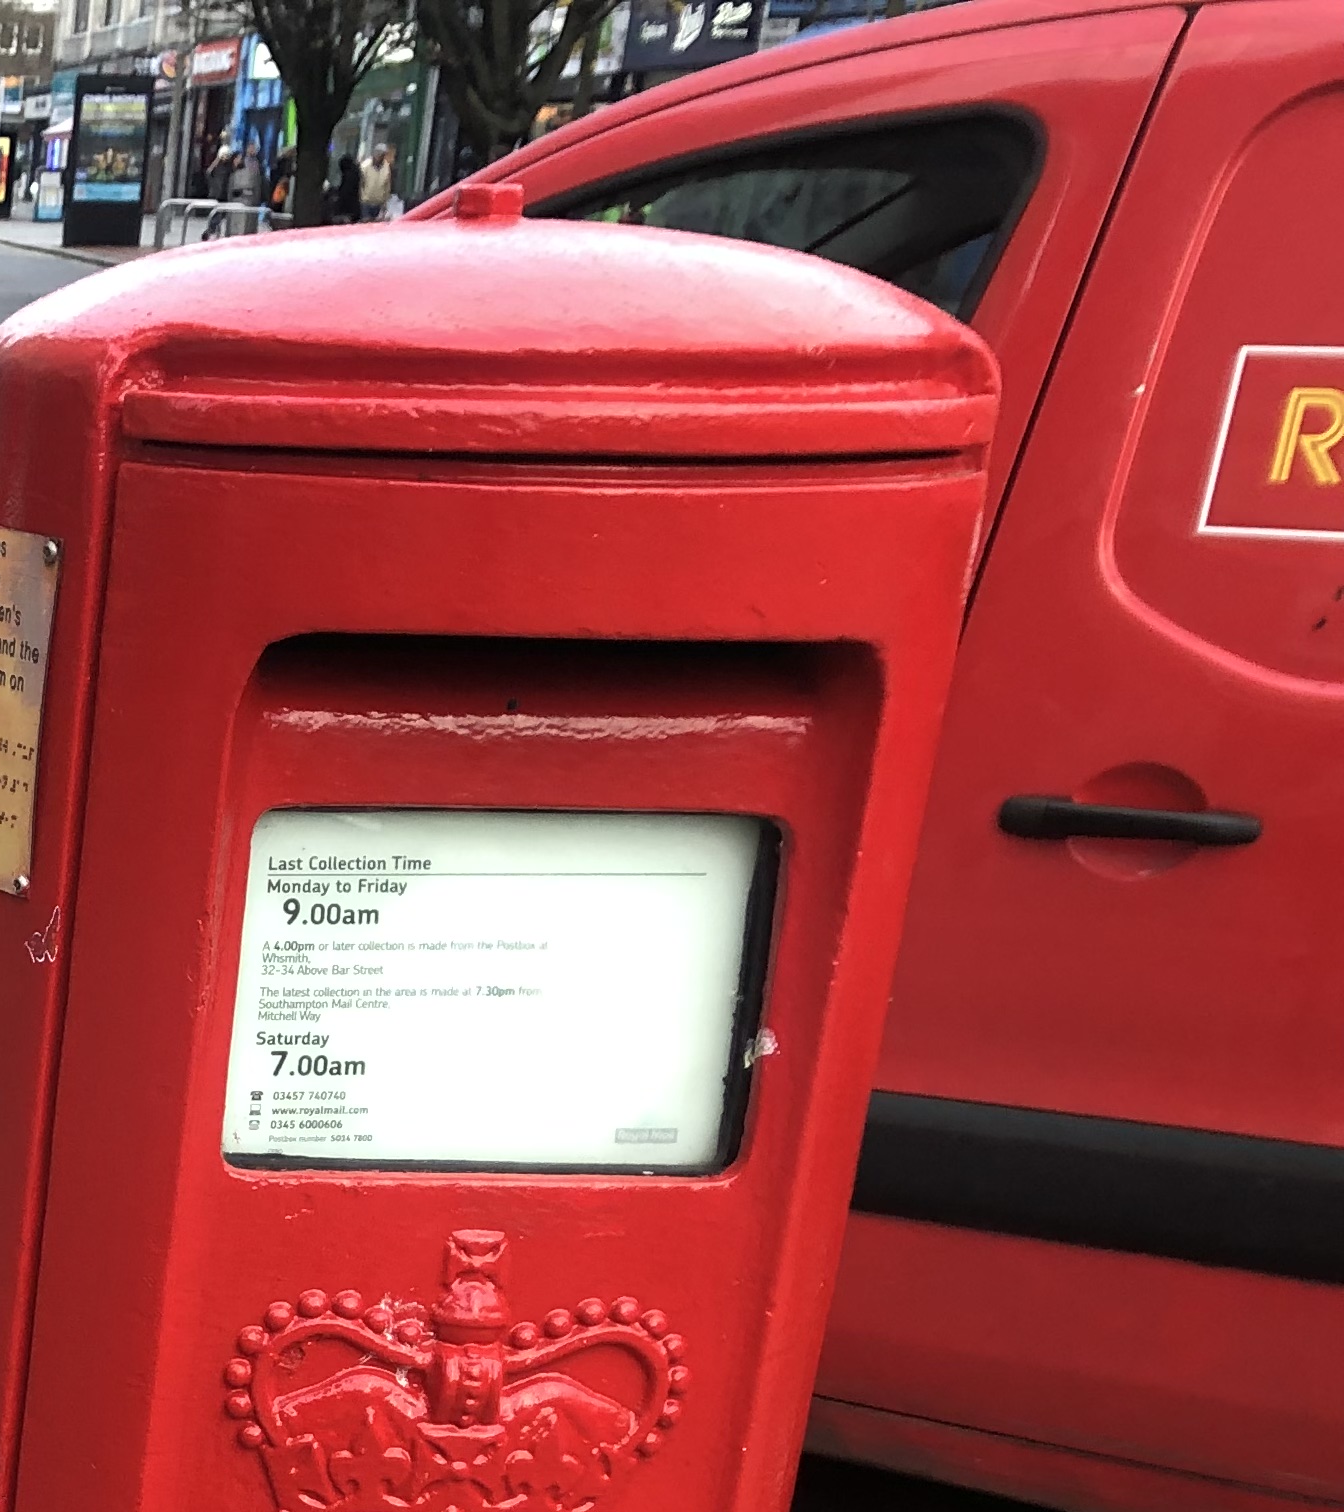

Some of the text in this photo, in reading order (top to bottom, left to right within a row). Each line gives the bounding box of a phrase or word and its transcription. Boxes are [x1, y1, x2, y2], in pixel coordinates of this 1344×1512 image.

[20, 640, 40, 664] the
[9, 673, 24, 692] on
[268, 856, 432, 871] Last Collection Time
[267, 878, 408, 896] Monday to Friday
[282, 898, 380, 925] 9.00am
[262, 941, 270, 951] A
[273, 941, 315, 952] 4.00pm
[318, 942, 329, 951] or
[332, 941, 355, 951] later
[358, 941, 405, 951] collection
[408, 942, 415, 951] is
[419, 941, 447, 951] made
[450, 941, 474, 951] from
[477, 941, 493, 950] the
[497, 940, 535, 951] Postbox
[262, 953, 311, 964] Whsmith,
[261, 965, 384, 975] 32-34 Above Bar Street
[260, 986, 542, 997] The latest collection in the area is made at 7.30pm from
[258, 998, 390, 1011] Southampton Mail Centre,
[258, 1011, 321, 1023] Mitchell Way
[256, 1031, 330, 1048] Saturday
[270, 1051, 366, 1077] 7.00am
[273, 1091, 346, 1101] 03457 740740
[272, 1105, 368, 1116] www.royalmail.com
[270, 1120, 343, 1129] 0345 6000606
